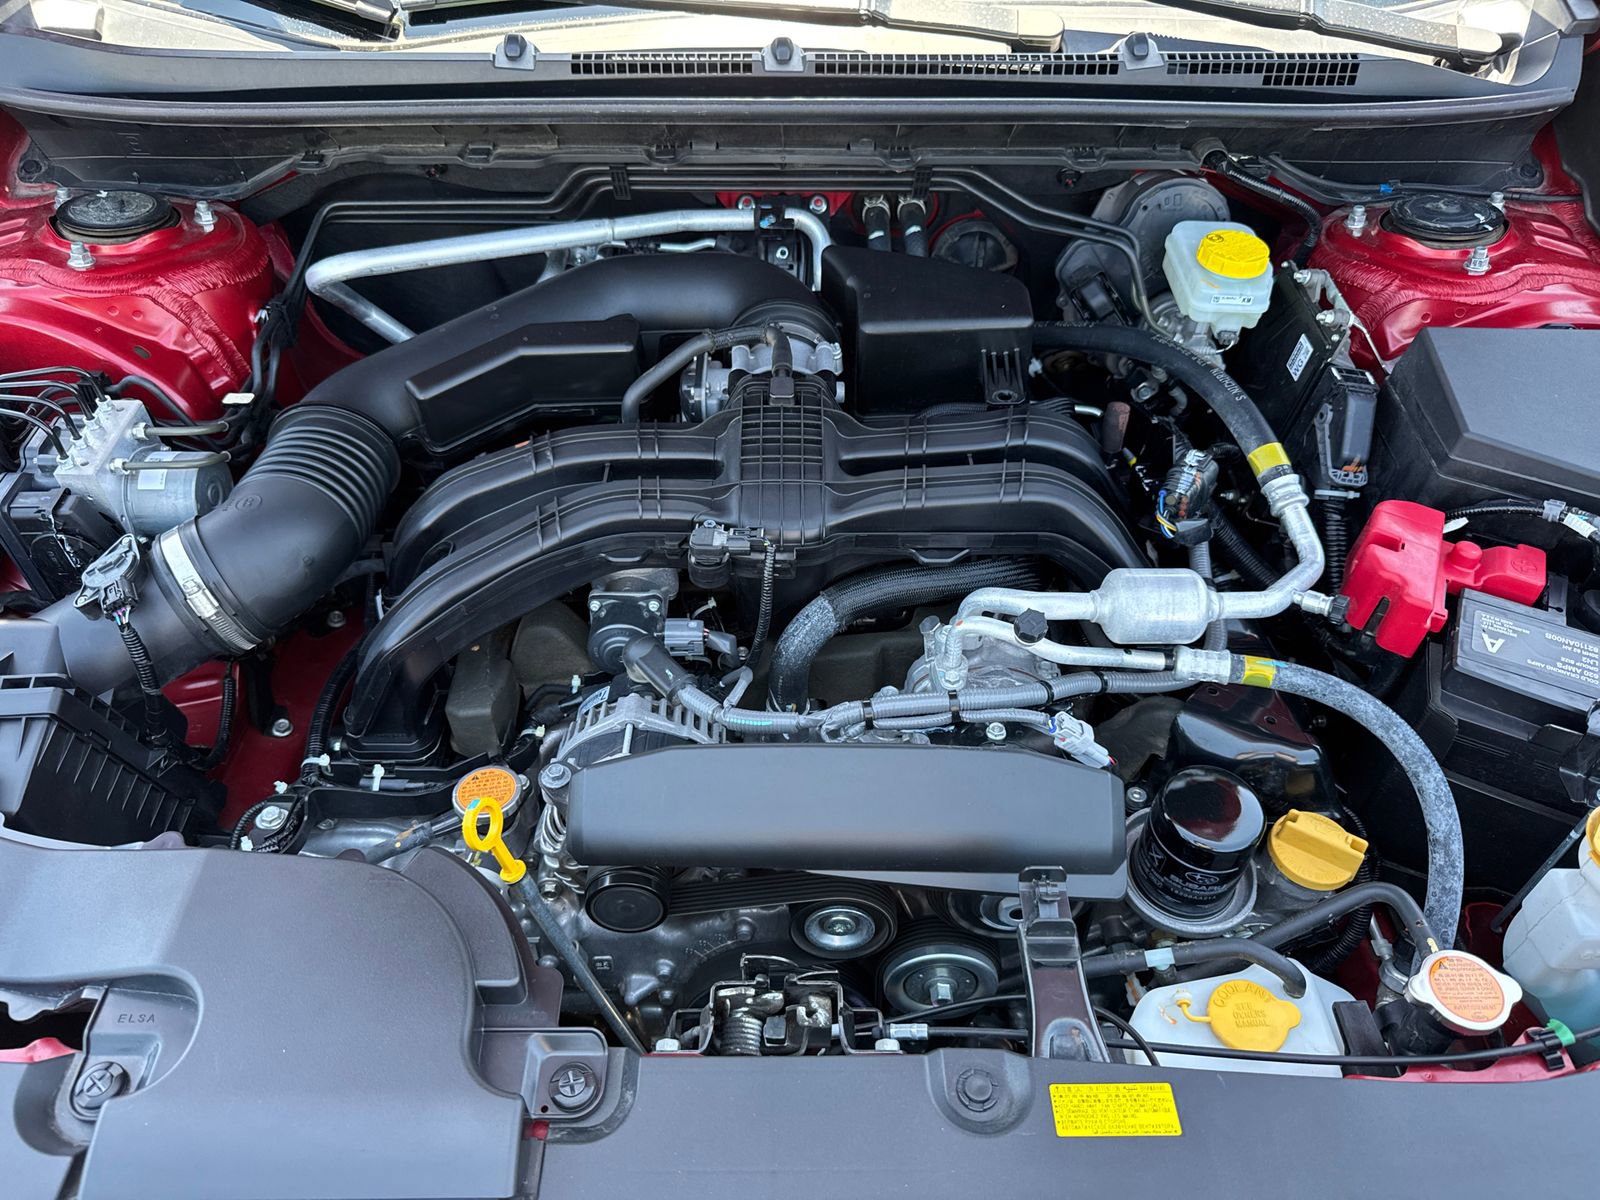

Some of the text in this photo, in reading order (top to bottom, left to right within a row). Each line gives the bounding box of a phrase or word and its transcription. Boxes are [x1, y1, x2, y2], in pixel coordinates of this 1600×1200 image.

[1527, 658, 1546, 668] AMPS
[1576, 662, 1599, 672] GROUP
[1546, 664, 1580, 679] CRANKING
[1556, 662, 1599, 680] 620 AMPS
[1213, 982, 1274, 1008] COOLANT
[118, 1013, 154, 1024] ELSA
[1235, 1019, 1271, 1028] MANUAL
